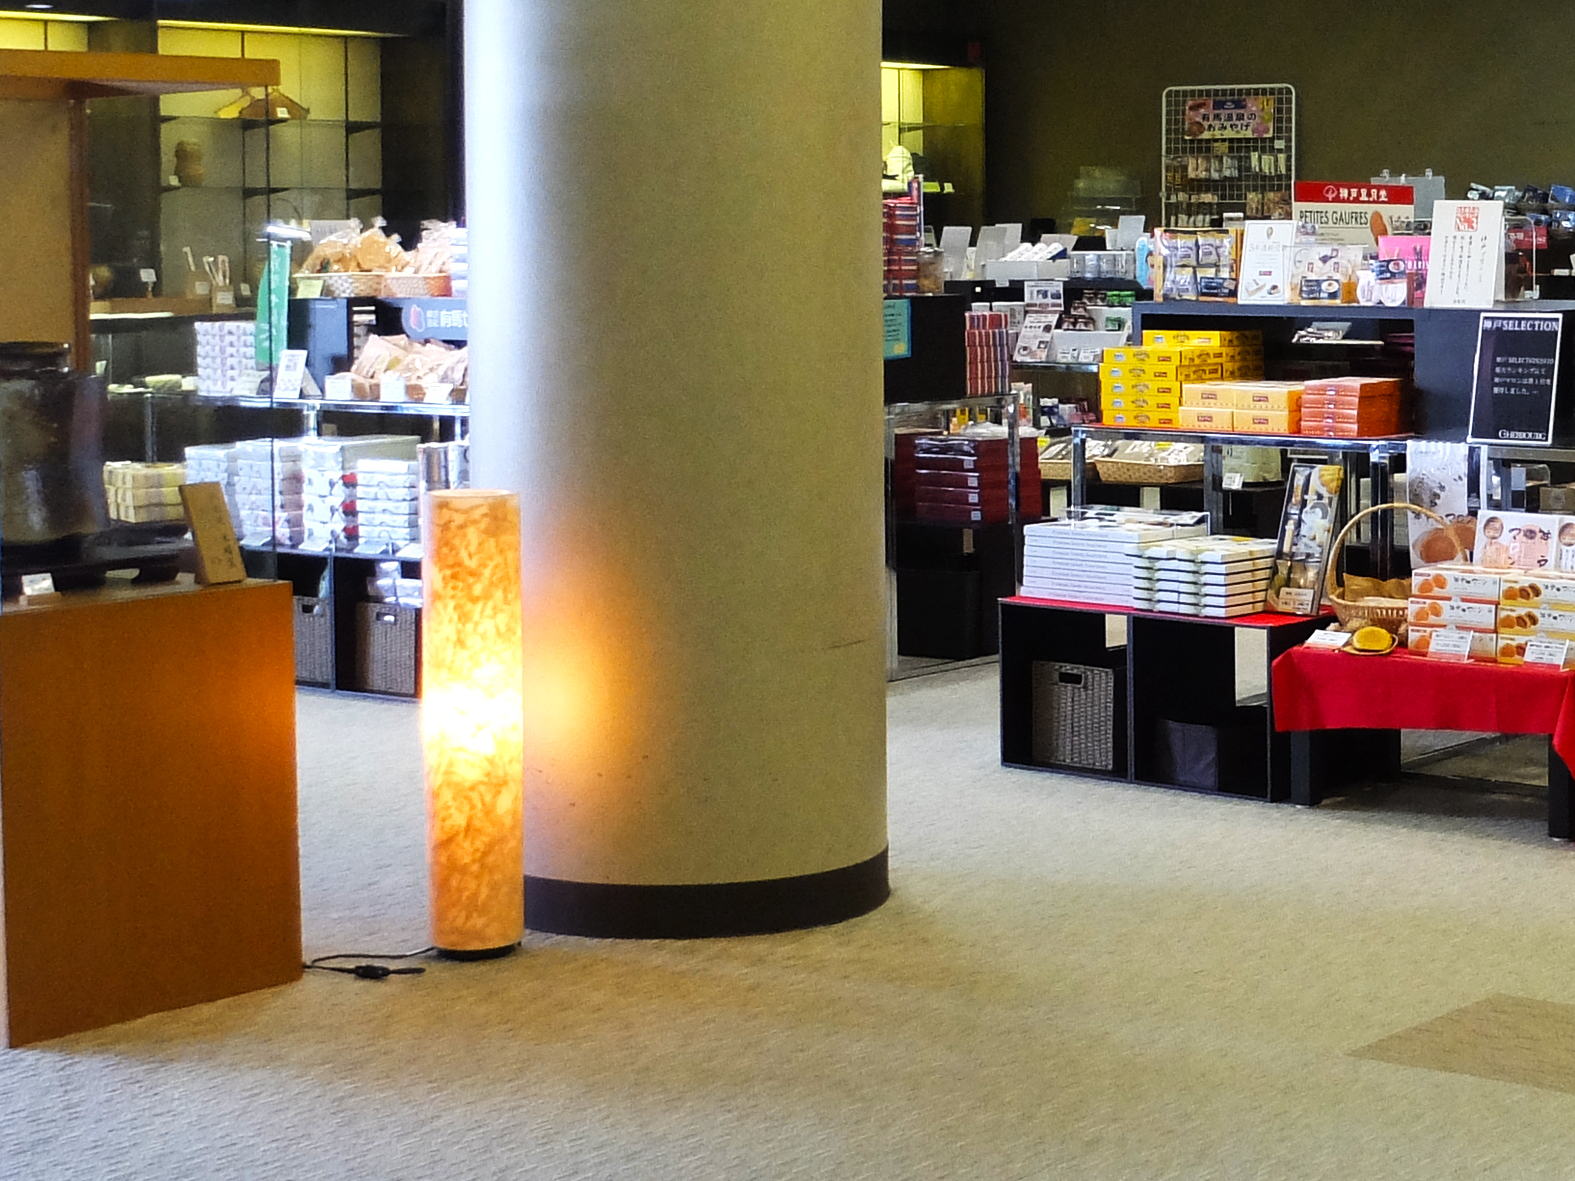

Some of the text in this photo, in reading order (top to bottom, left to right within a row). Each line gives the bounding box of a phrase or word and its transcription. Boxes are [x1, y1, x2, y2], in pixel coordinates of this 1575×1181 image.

[1201, 112, 1257, 123] 有馬温泉の
[1299, 209, 1369, 226] PETITES GAUFRES
